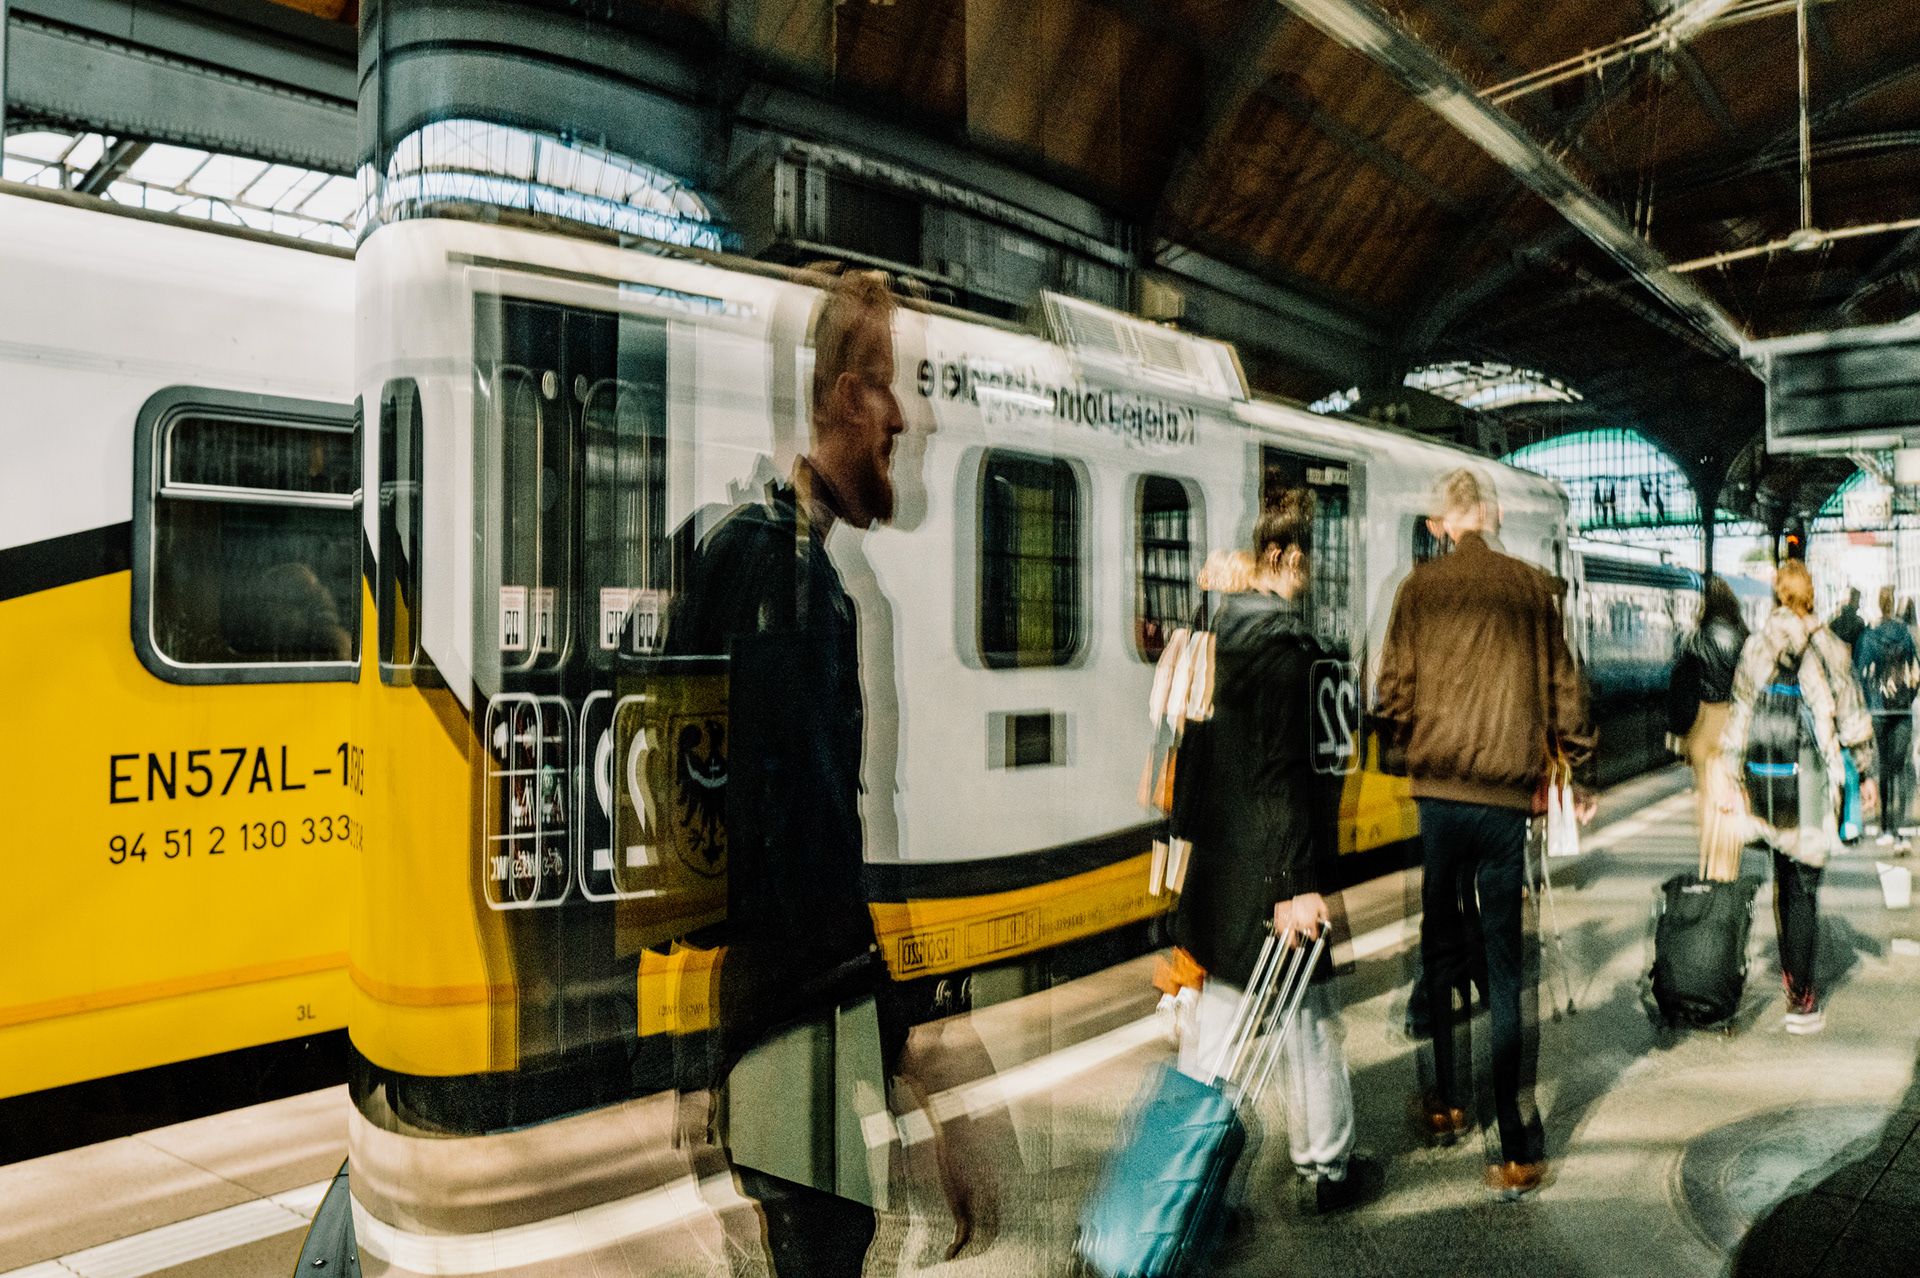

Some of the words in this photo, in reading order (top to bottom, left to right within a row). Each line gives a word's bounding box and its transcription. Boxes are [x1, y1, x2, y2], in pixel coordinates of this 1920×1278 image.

[109, 832, 148, 865] 94
[163, 828, 192, 859] 51
[209, 826, 225, 855] 2
[240, 820, 286, 851] 130
[301, 814, 351, 845] 333
[296, 1003, 317, 1021] 3L
